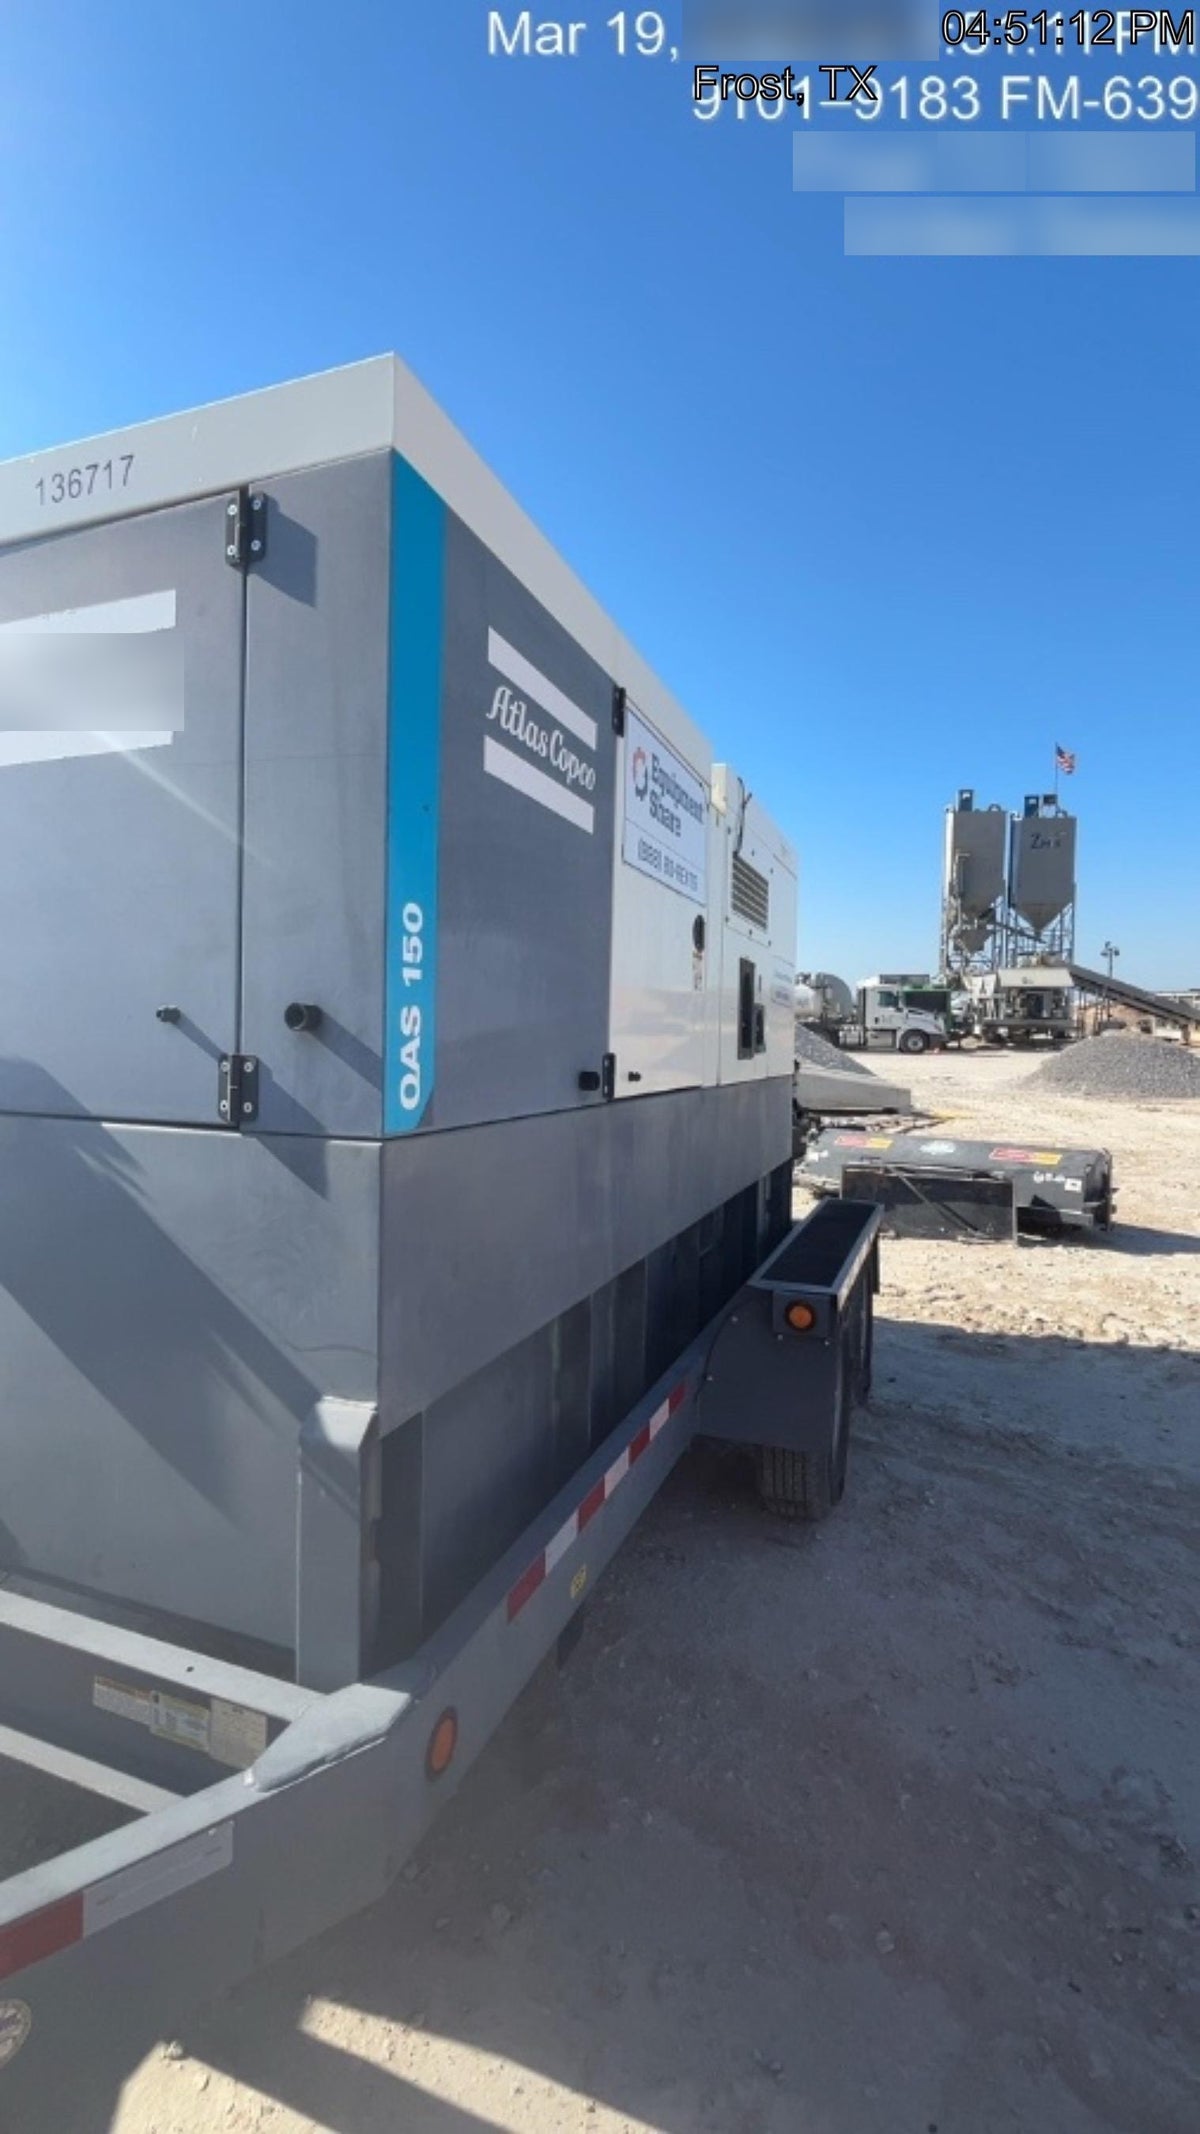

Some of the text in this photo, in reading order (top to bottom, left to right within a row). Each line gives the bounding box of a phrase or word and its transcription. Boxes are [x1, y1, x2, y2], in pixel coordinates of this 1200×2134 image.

[35, 454, 135, 506] 136717
[486, 686, 596, 791] Atlas Copco
[402, 903, 424, 987] 150
